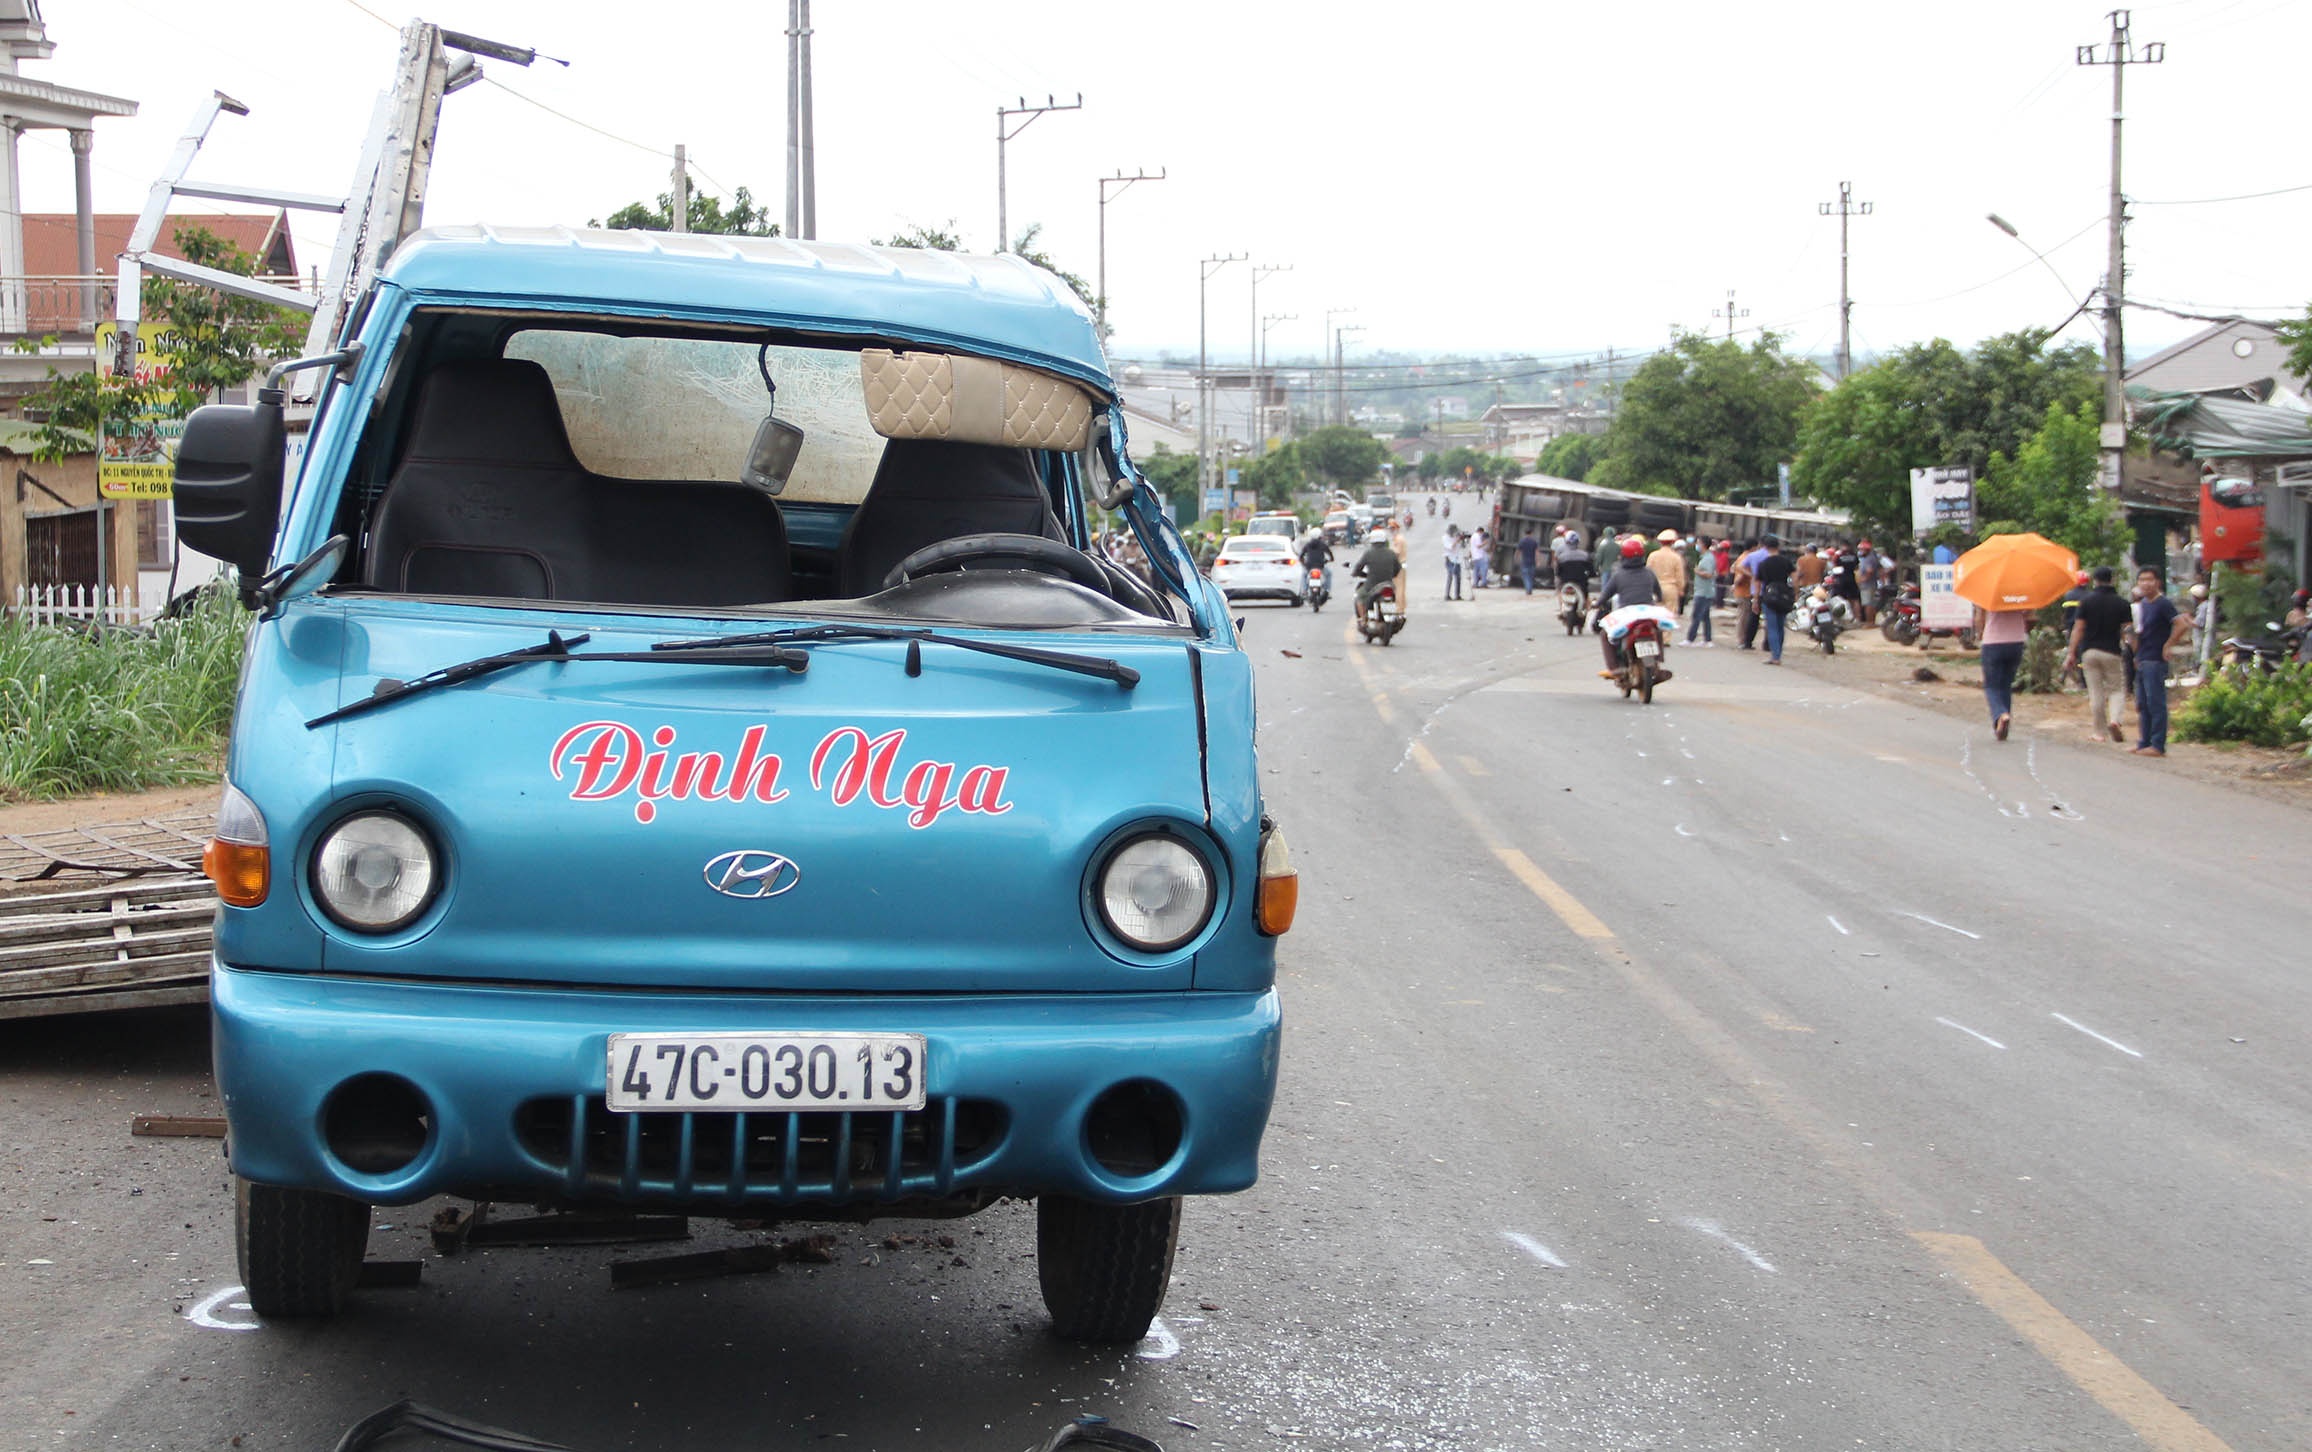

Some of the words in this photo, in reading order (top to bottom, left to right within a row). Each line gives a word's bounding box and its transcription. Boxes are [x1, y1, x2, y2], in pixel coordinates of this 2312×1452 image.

[131, 482, 148, 493] Tel:
[150, 482, 168, 493] 098
[550, 720, 790, 825] Định
[809, 726, 1014, 831] Nga
[621, 1043, 914, 1101] 47C-030.13
